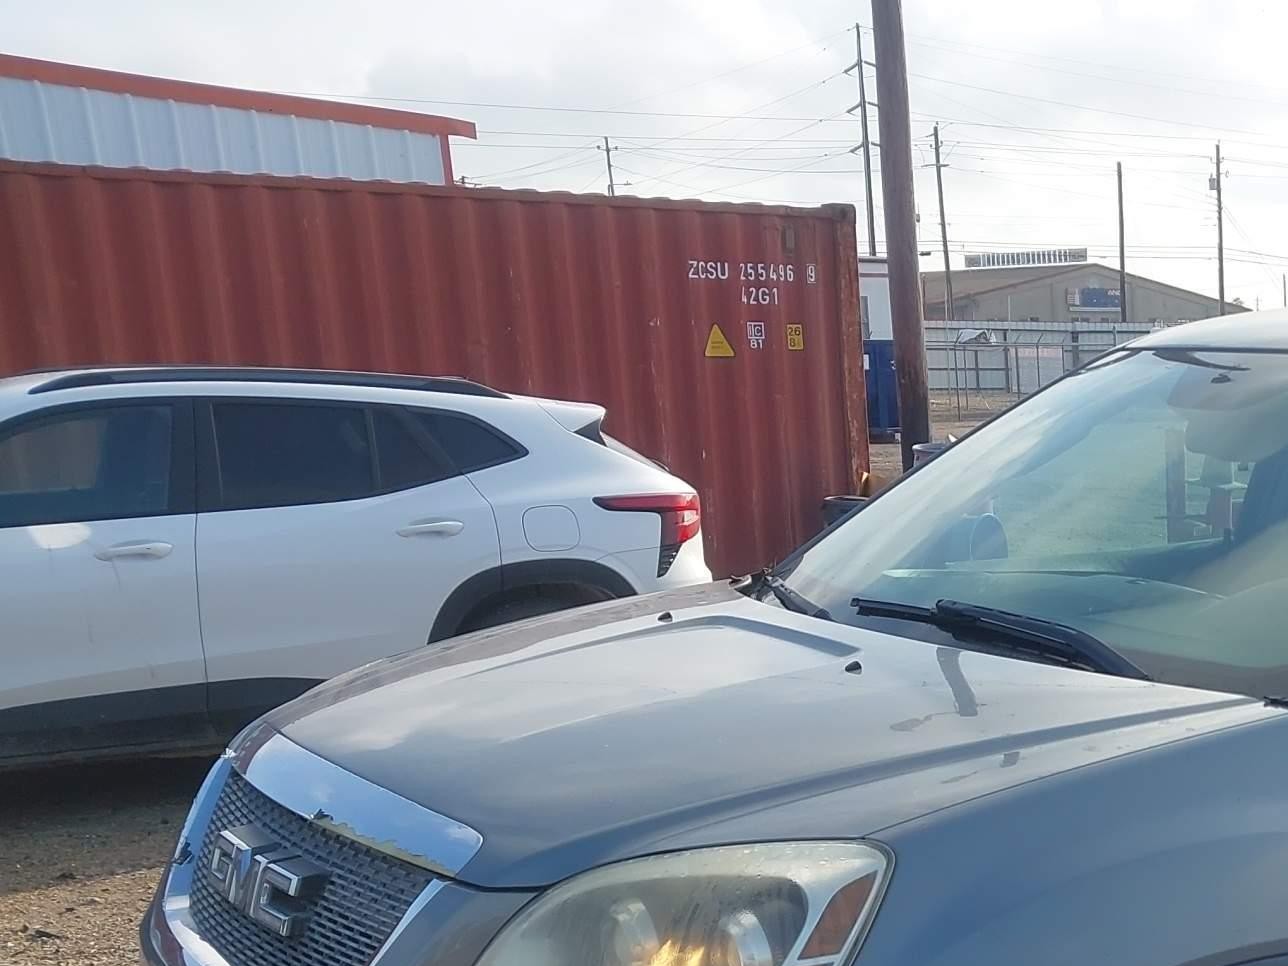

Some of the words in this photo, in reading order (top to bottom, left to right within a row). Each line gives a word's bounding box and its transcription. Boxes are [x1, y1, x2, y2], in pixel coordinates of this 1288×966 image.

[688, 261, 728, 279] ZCSU
[740, 263, 794, 282] 255496
[807, 264, 816, 282] 9
[741, 286, 778, 304] 42G1
[750, 339, 763, 349] 81
[209, 829, 300, 938] GMC
